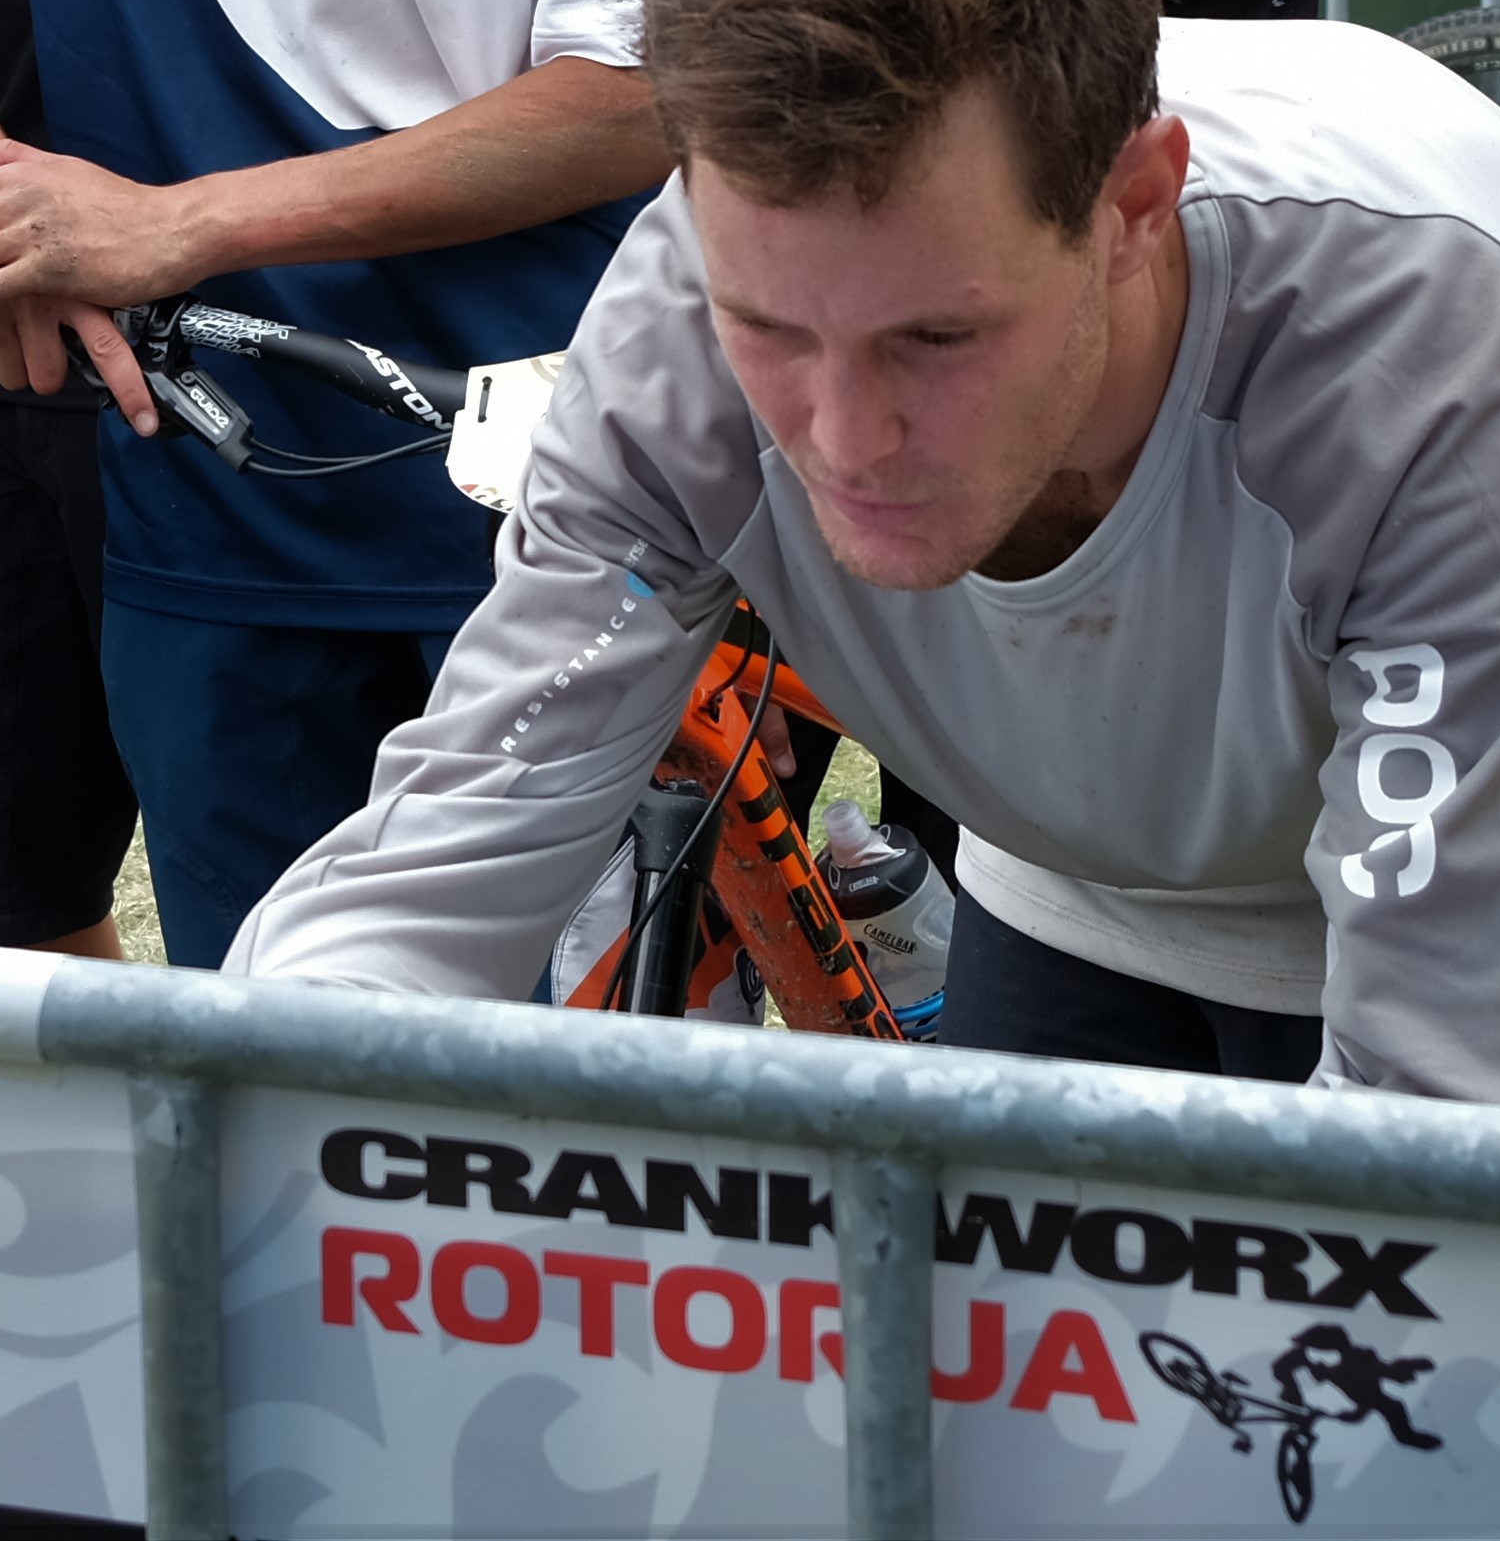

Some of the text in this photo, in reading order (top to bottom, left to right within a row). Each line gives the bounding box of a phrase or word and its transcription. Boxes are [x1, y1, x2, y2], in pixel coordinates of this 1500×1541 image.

[500, 596, 637, 753] RESISTANCE
[863, 923, 915, 955] CAMELBAK
[320, 1225, 1138, 1425] ROTORUA
